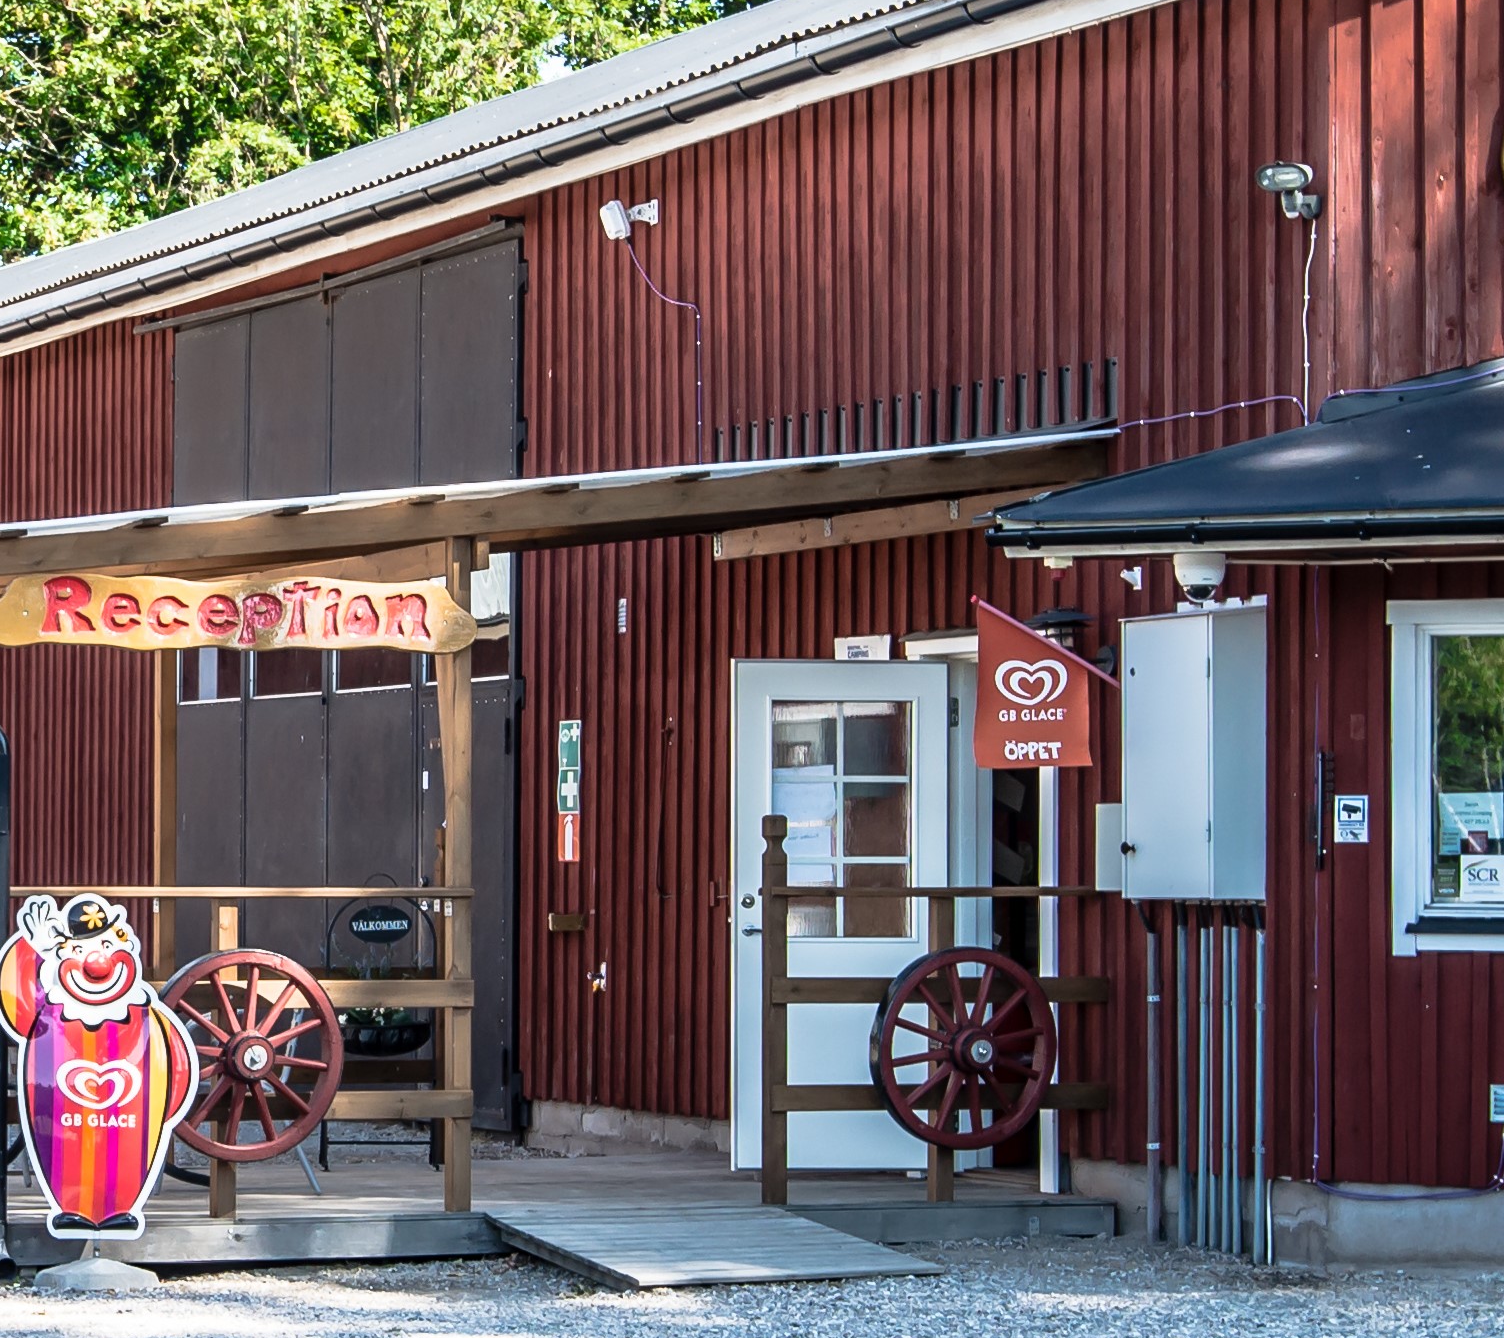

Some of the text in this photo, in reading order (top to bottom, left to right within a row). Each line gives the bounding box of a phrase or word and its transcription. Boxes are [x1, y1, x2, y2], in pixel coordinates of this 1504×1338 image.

[41, 575, 432, 645] Reception
[998, 708, 1064, 722] GB GLACE
[1004, 740, 1062, 761] ÖPPET
[1468, 868, 1500, 882] SCR
[352, 919, 408, 932] VÄLKOMMEN
[60, 1112, 137, 1128] GB GLACE
